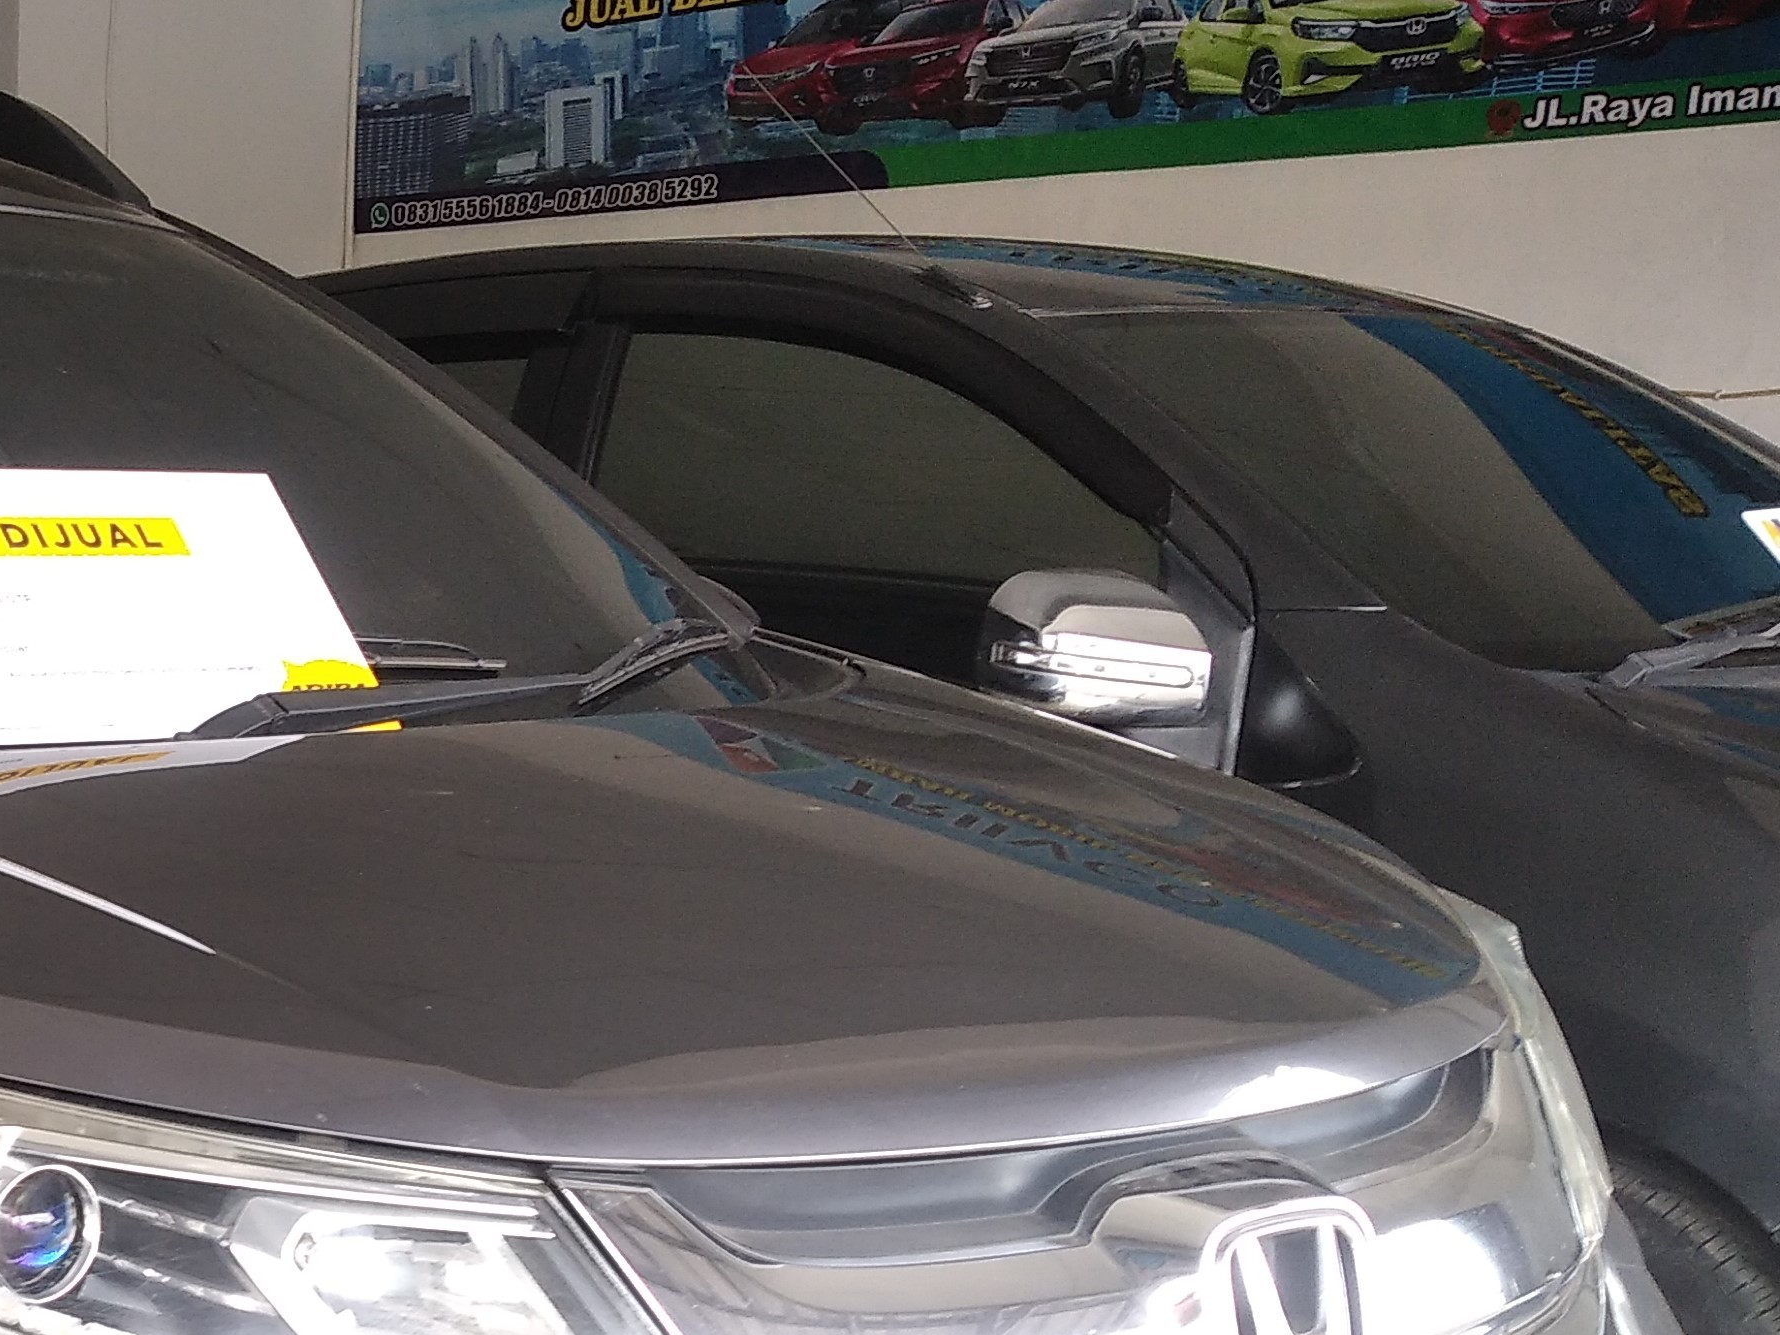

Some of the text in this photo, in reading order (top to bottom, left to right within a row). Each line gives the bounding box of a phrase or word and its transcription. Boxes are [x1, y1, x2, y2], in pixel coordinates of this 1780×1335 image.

[1523, 93, 1675, 128] JL.Raya
[391, 201, 441, 227] 0831
[441, 196, 492, 223] 5556
[493, 192, 543, 219] 1884
[554, 186, 607, 212] 0814
[606, 181, 659, 208] 0038
[664, 174, 718, 201] 5292
